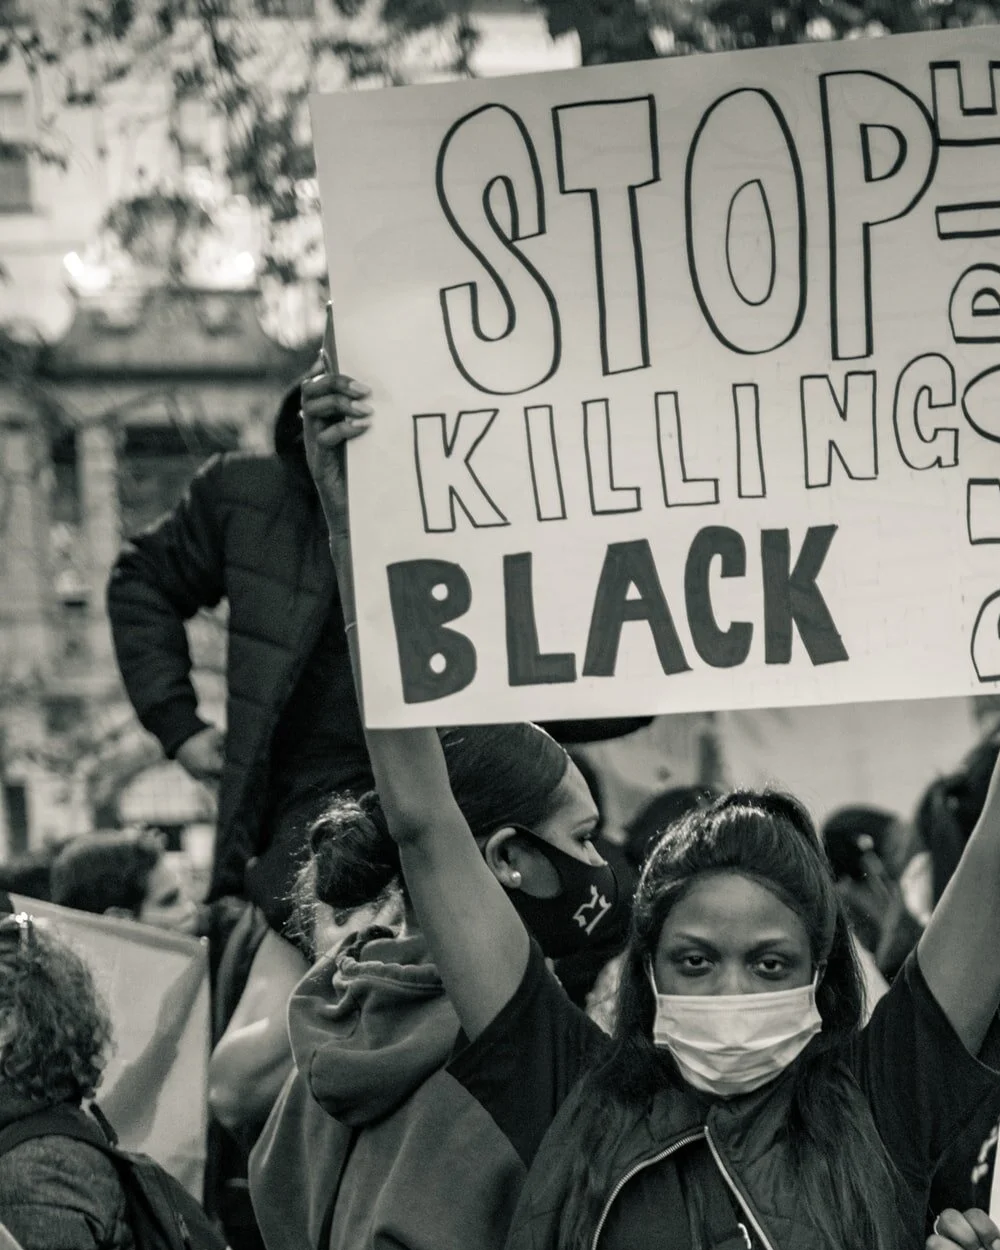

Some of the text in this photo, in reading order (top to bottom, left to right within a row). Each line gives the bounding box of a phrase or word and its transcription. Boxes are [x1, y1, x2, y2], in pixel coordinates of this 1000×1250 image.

[435, 69, 939, 395] STOP
[412, 353, 960, 533] KILLING
[386, 524, 849, 704] BLACK
